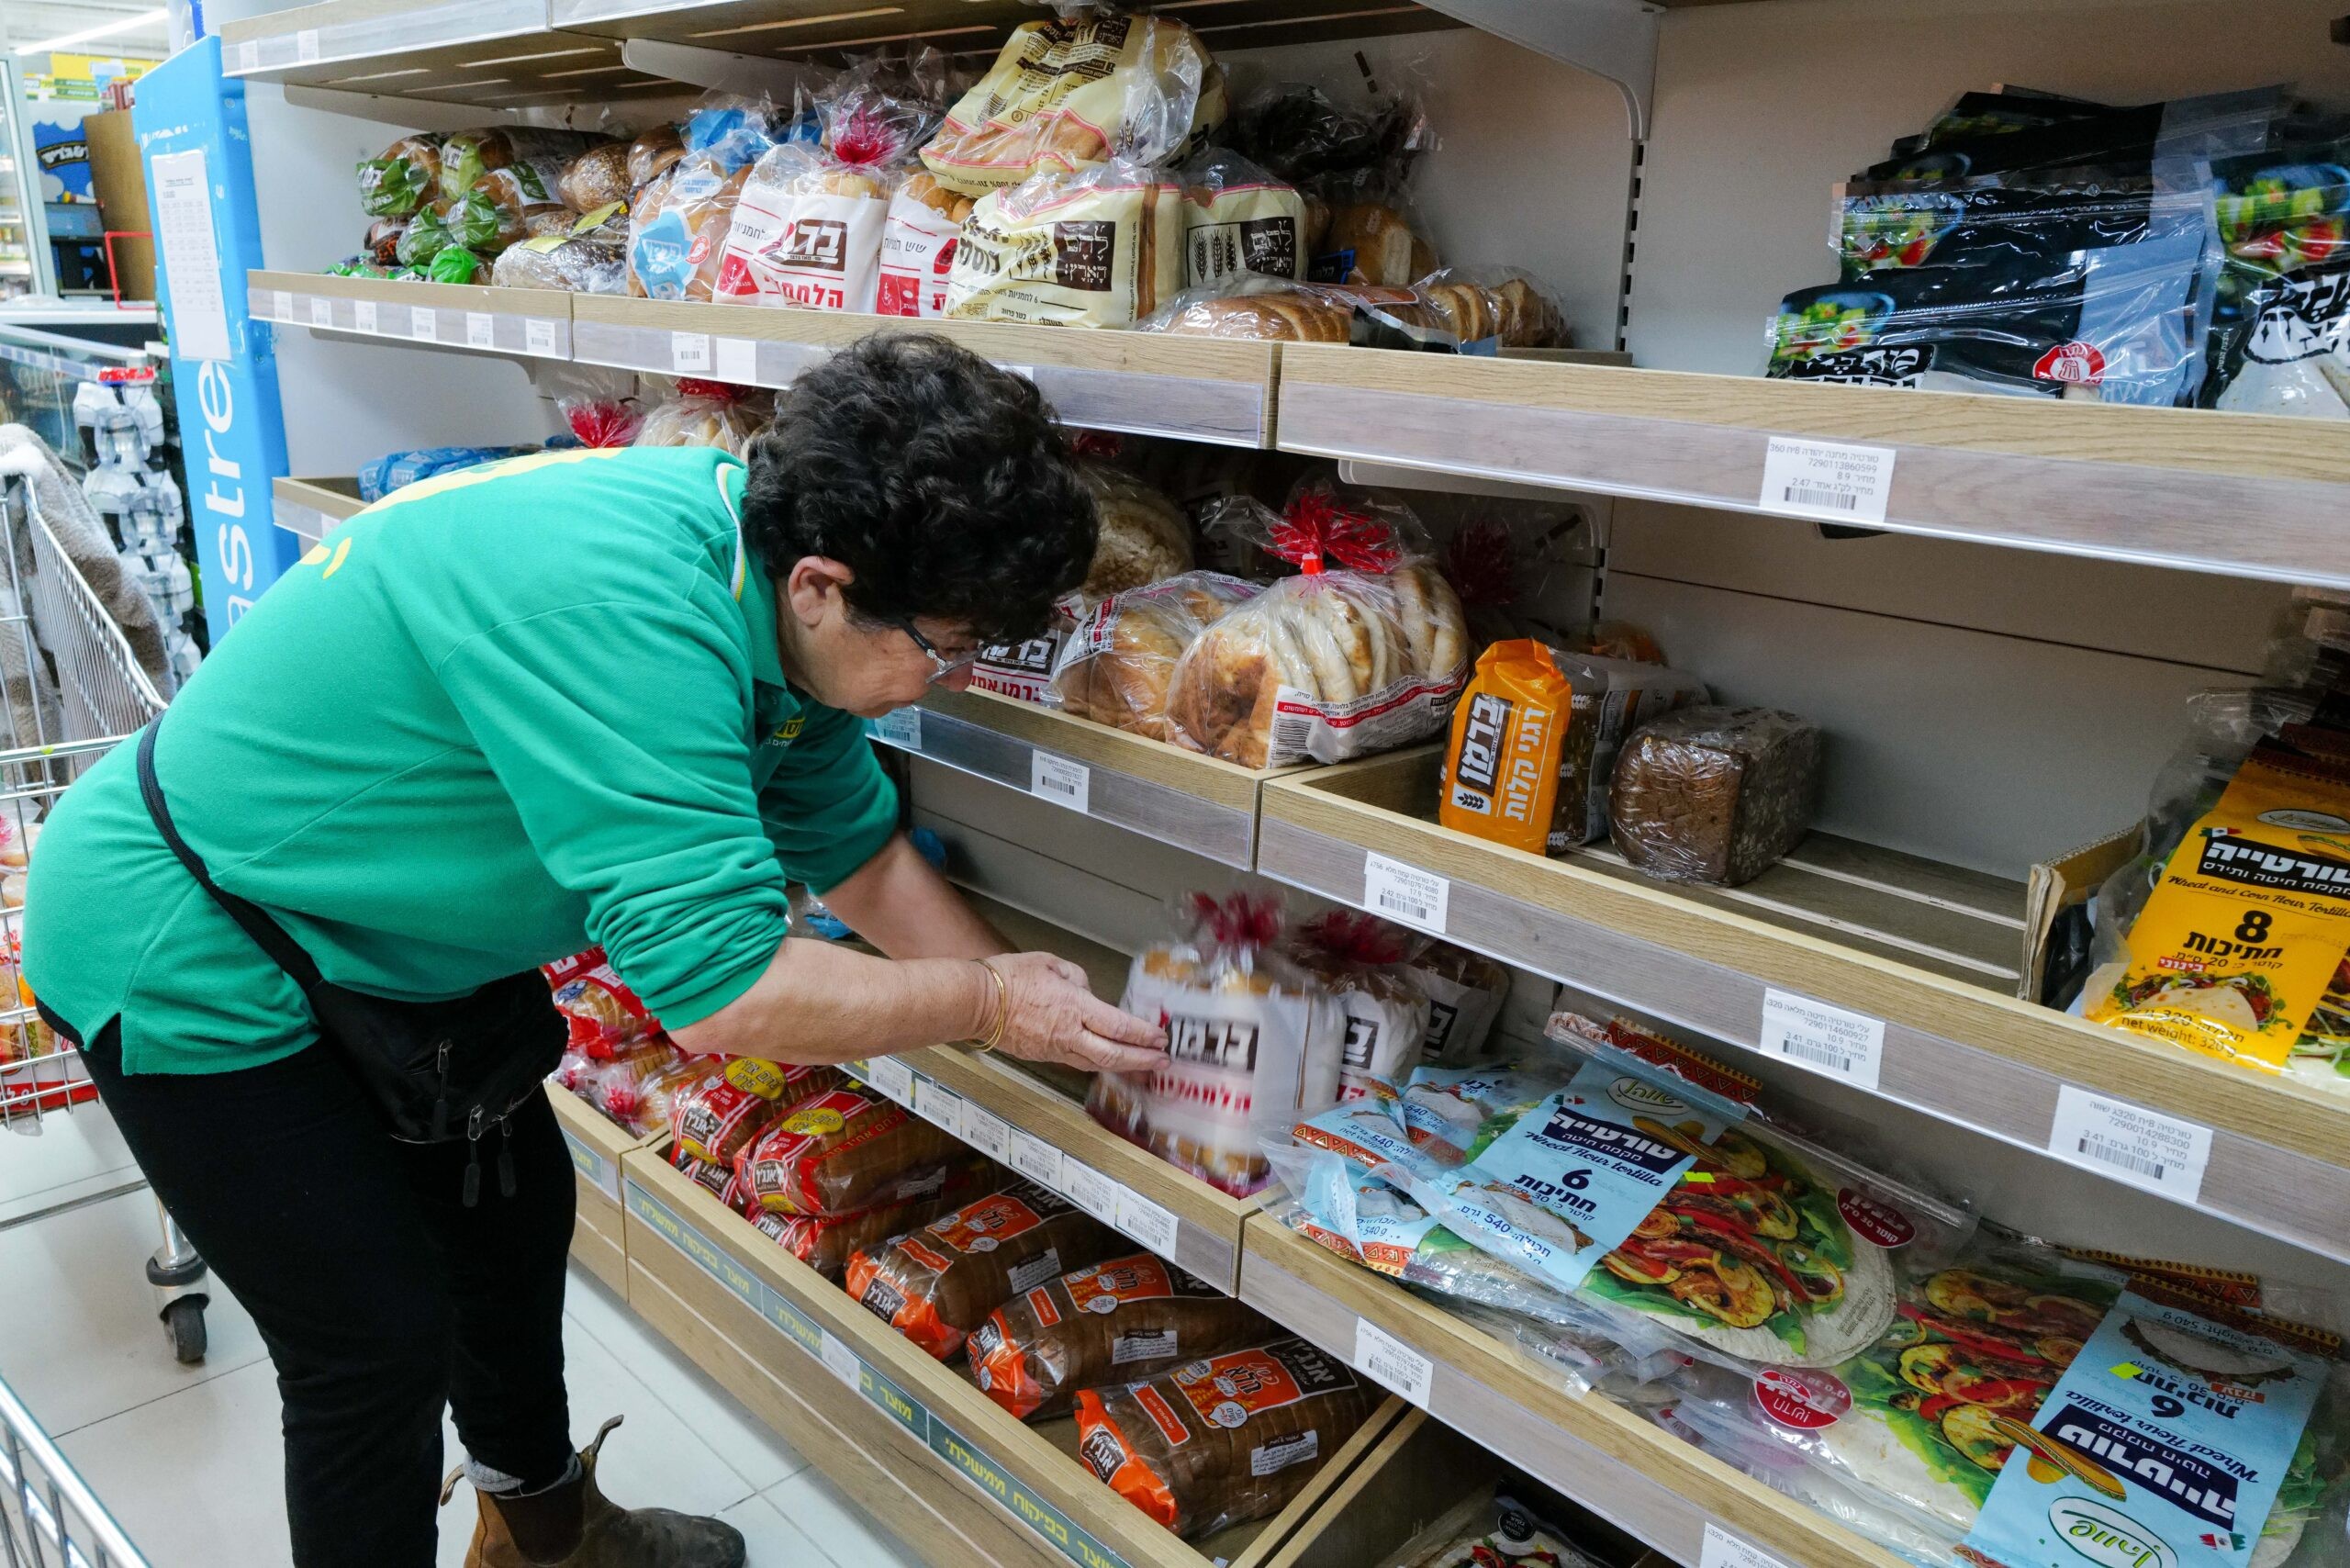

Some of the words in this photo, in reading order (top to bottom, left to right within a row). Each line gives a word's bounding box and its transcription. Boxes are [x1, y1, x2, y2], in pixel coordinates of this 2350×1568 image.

[1769, 443, 1785, 453] 360
[1808, 457, 1877, 473] 7290113860599
[1517, 707, 1545, 753] דגני
[1459, 696, 1500, 786] ברמן
[1505, 758, 1538, 822] קלות
[2203, 861, 2249, 879] ותירס
[1394, 875, 1438, 895] 7290107974080
[2254, 872, 2296, 887] חיטה
[2168, 875, 2209, 890] Wheat
[2209, 883, 2236, 896] and
[2239, 890, 2270, 902] Corn
[2270, 894, 2306, 909] Flour
[2234, 910, 2273, 943] 8
[2183, 931, 2283, 960] חתיכות
[2159, 958, 2204, 972] בינוני
[2208, 958, 2229, 968] 20
[1784, 1004, 1806, 1016] מלאה
[1807, 1011, 1826, 1021] חיטה
[1804, 1017, 1869, 1042] 7290114600927
[1828, 1016, 1855, 1028] טורטיה
[2121, 1016, 2143, 1029] net
[2146, 1022, 2197, 1044] weight:
[1785, 1031, 1802, 1042] 3.41
[1828, 1034, 1844, 1044] 10.9
[1824, 1043, 1839, 1053] 100
[1548, 1112, 1677, 1159] טורטייה
[1561, 1133, 1597, 1147] חיטה
[2084, 1129, 2104, 1142] 3.41
[2109, 1116, 2190, 1149] 7290014288300
[2156, 1123, 2192, 1140] טורטיה
[1370, 1134, 1393, 1148] 540
[2136, 1136, 2158, 1148] 10.9
[1523, 1130, 1571, 1152] Wheat
[1611, 1159, 1663, 1187] tortilla
[1599, 1143, 1642, 1161] מקמח
[2131, 1146, 2150, 1159] 100
[2163, 1157, 2185, 1170] מחיר
[1561, 1169, 1593, 1191] 6
[1514, 1173, 1597, 1214] חתיכות
[1531, 1194, 1550, 1203] 30
[638, 1196, 679, 1238] ממשלתי
[1457, 1204, 1482, 1219] גרם.
[1569, 1208, 1596, 1221] קוטר
[1483, 1214, 1511, 1234] 540
[1861, 1216, 1874, 1228] 30
[1875, 1226, 1899, 1243] קוטר
[682, 1232, 719, 1270] בפיקוח
[723, 1264, 750, 1294] מוצר
[2174, 1316, 2199, 1328] 540
[879, 1385, 912, 1421] מוצר
[1773, 1397, 1811, 1423] חדש!
[2151, 1394, 2186, 1418] 6
[2098, 1422, 2157, 1451] מקמח
[2161, 1450, 2211, 1479] חיטה
[945, 1437, 1006, 1496] ממשלתי
[2057, 1424, 2236, 1520] טורטייה
[1013, 1490, 1069, 1546] בפיקוח
